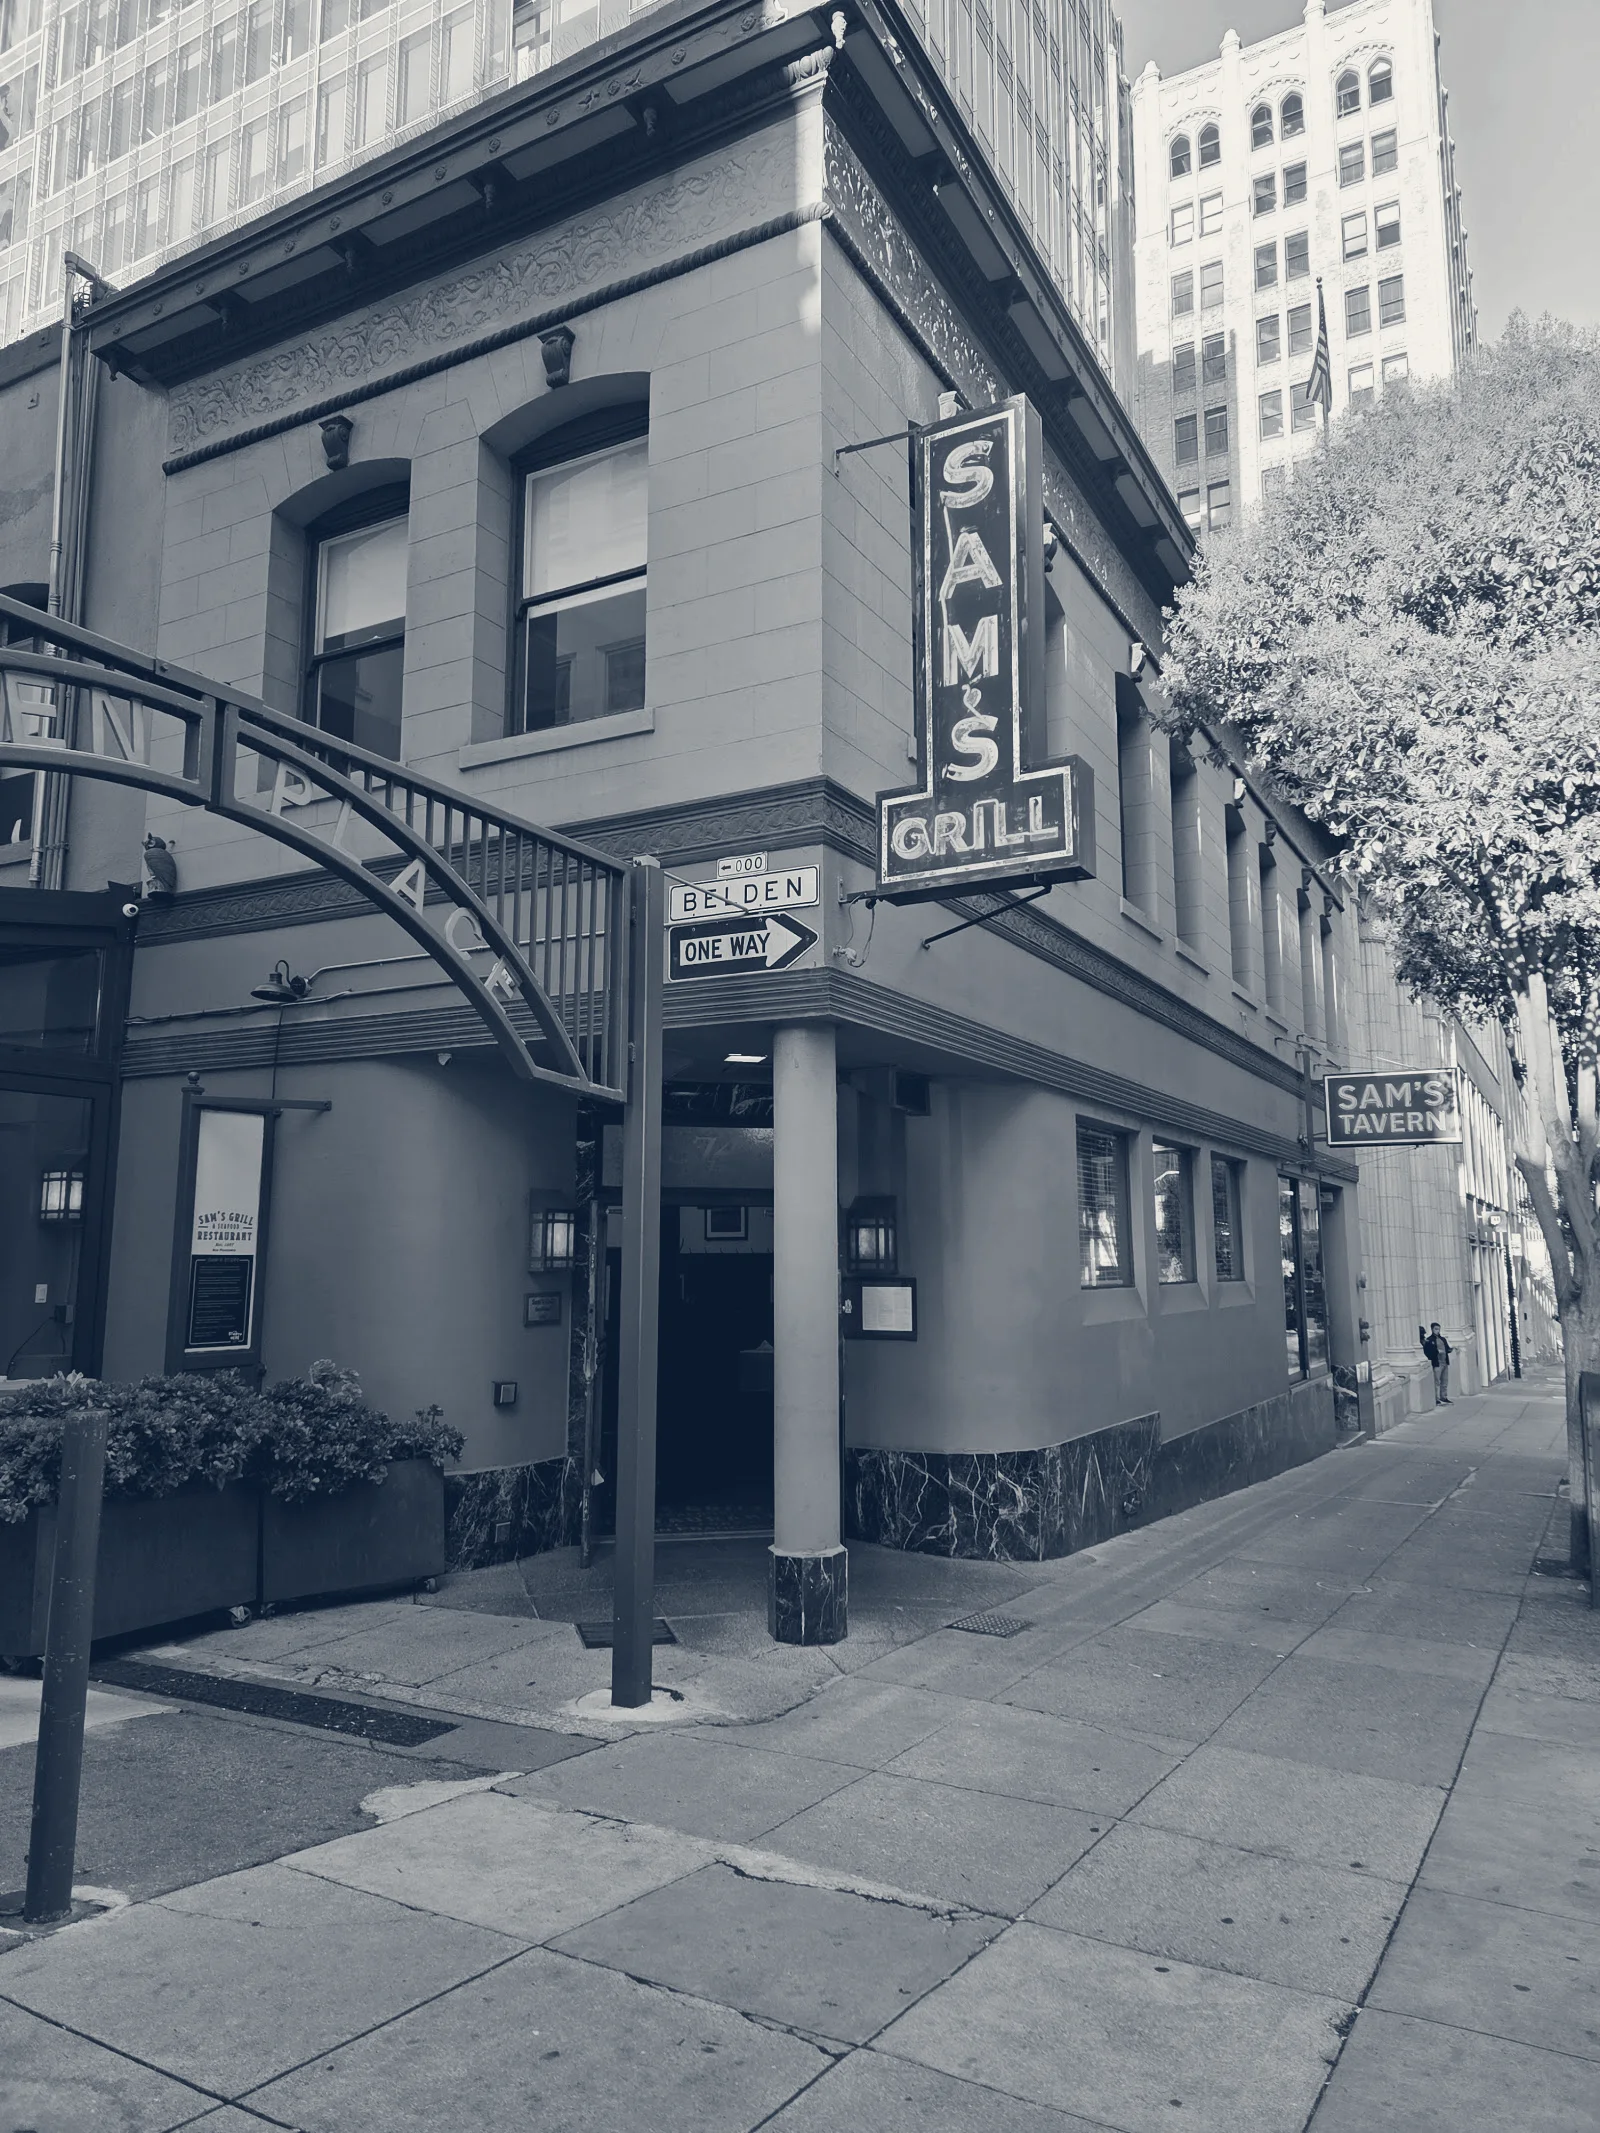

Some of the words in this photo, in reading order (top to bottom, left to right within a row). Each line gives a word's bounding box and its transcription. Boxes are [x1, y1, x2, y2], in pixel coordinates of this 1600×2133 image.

[940, 440, 1003, 782] SAM'S
[0, 671, 150, 767] EN
[271, 758, 523, 1014] PLACE
[891, 795, 1059, 860] GRILL
[735, 856, 763, 873] 000
[683, 876, 802, 912] BELDEN
[685, 938, 723, 962] ONE
[730, 932, 771, 957] WAY
[1337, 1080, 1445, 1111] SAM'S
[1338, 1110, 1447, 1135] TAVERN
[198, 1210, 226, 1225] SAM'S
[228, 1212, 254, 1226] GRILL
[197, 1230, 253, 1241] RESTAURANT
